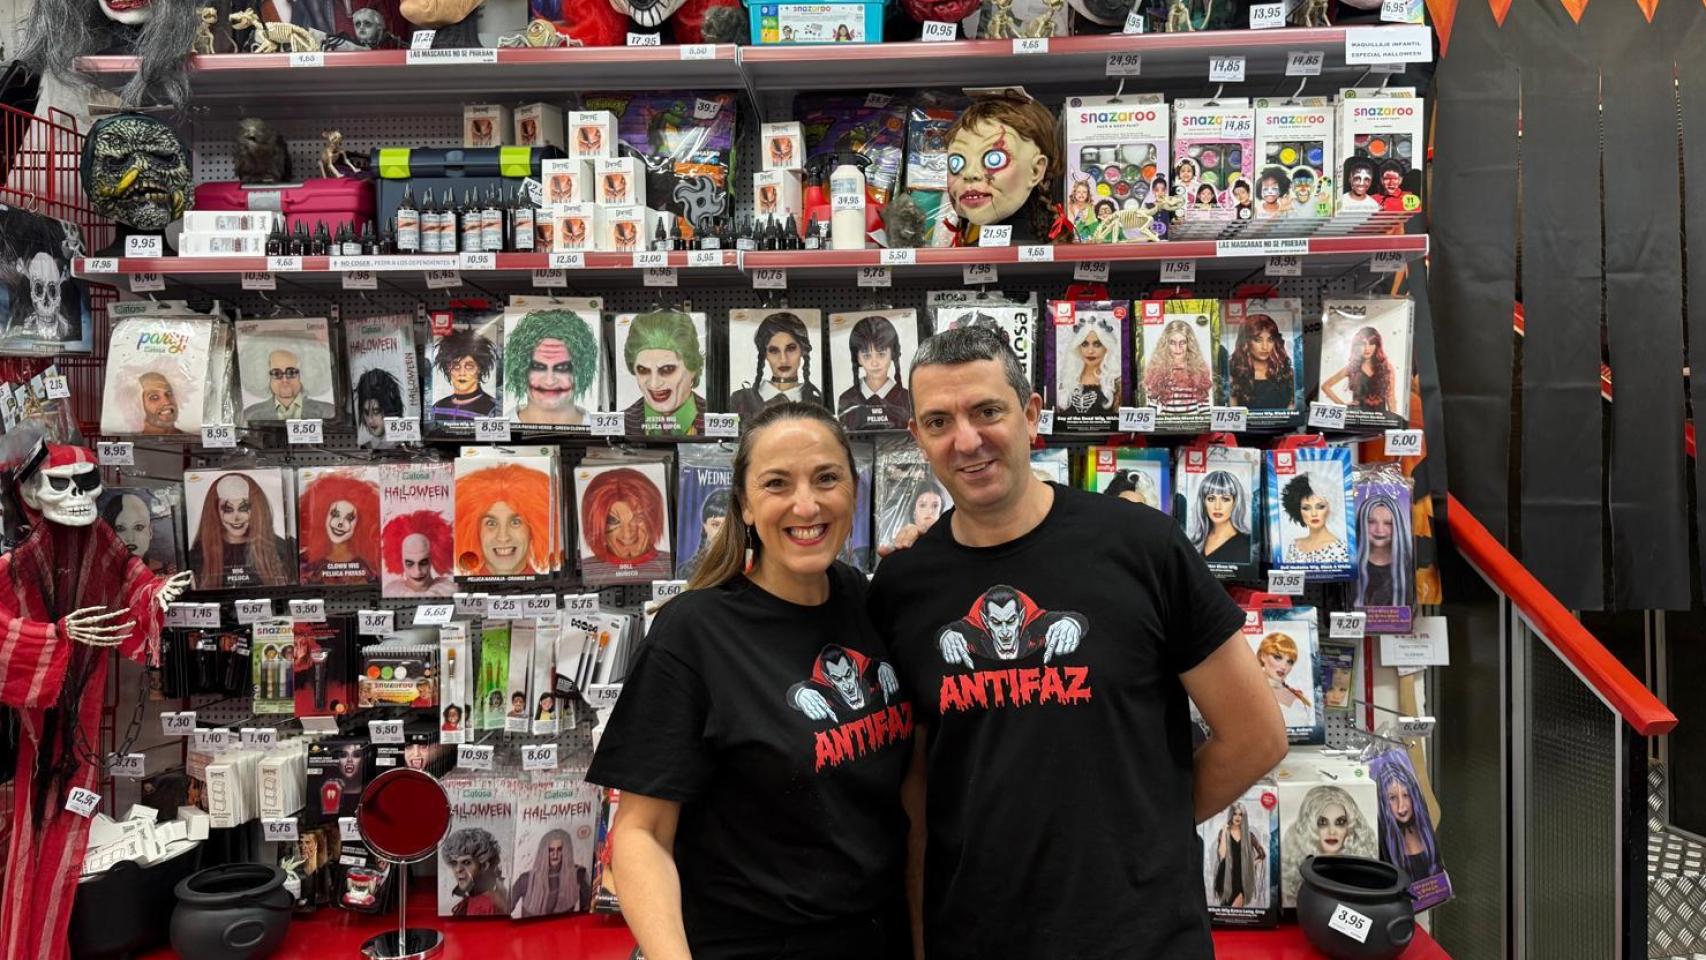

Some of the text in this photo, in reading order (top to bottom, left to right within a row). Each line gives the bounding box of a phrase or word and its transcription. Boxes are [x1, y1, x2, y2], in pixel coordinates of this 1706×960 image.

[1253, 7, 1281, 20] 13,95
[925, 25, 953, 37] 10,95
[1109, 55, 1138, 66] 24,95
[1213, 59, 1241, 73] 14,85
[1291, 55, 1319, 66] 14,85
[1080, 110, 1156, 124] snazaroo
[1354, 106, 1414, 117] snazaroo
[1266, 114, 1325, 125] snazaroo
[1224, 120, 1251, 132] 14,85
[837, 195, 860, 205] 34,95
[982, 227, 1008, 239] 21,95
[130, 238, 156, 249] 9,95
[1219, 241, 1229, 249] LAS
[1230, 240, 1262, 248] MASCARAS
[466, 255, 489, 264] 10,95
[639, 253, 662, 263] 21,00
[1269, 256, 1297, 267] 13,95
[90, 259, 112, 269] 17,95
[1164, 261, 1190, 273] 11,95
[755, 269, 783, 280] 10,75
[934, 291, 967, 302] atosa
[350, 337, 398, 354] HALLOWEEN
[404, 352, 418, 406] HALLOWEEN
[1126, 412, 1150, 423] 11,95
[1216, 411, 1241, 422] 11,95
[1314, 406, 1343, 420] 14,95
[390, 421, 413, 432] 8,95
[481, 421, 504, 432] 8,95
[596, 416, 619, 427] 9,75
[708, 418, 735, 429] 19,99
[207, 427, 228, 439] 8,95
[292, 423, 316, 434] 8,50
[1391, 434, 1417, 446] 6,00
[103, 445, 127, 457] 8,95
[698, 469, 733, 485] WEDNE
[384, 485, 449, 502] HALLOWEEN
[1271, 575, 1300, 587] 13,95
[658, 585, 681, 596] 6,60
[295, 604, 318, 614] 3,50
[493, 600, 515, 610] 6,25
[527, 599, 550, 609] 6,20
[571, 599, 593, 610] 5,75
[191, 608, 213, 618] 1,45
[423, 606, 447, 617] 5,65
[364, 615, 387, 627] 3,87
[1335, 618, 1359, 629] 4,20
[939, 664, 1092, 711] ANTIFAZ
[597, 688, 618, 700] 1,95
[167, 717, 189, 728] 7,30
[375, 724, 398, 735] 5,50
[202, 733, 222, 744] 1,40
[250, 733, 271, 744] 1,40
[461, 749, 489, 760] 10,95
[527, 749, 551, 760] 8,60
[450, 802, 512, 819] ALLOWEEN
[523, 801, 592, 820] HALLOWEEN
[269, 822, 291, 834] 6,75
[346, 823, 359, 833] 1,9
[1337, 908, 1366, 931] 3,95
